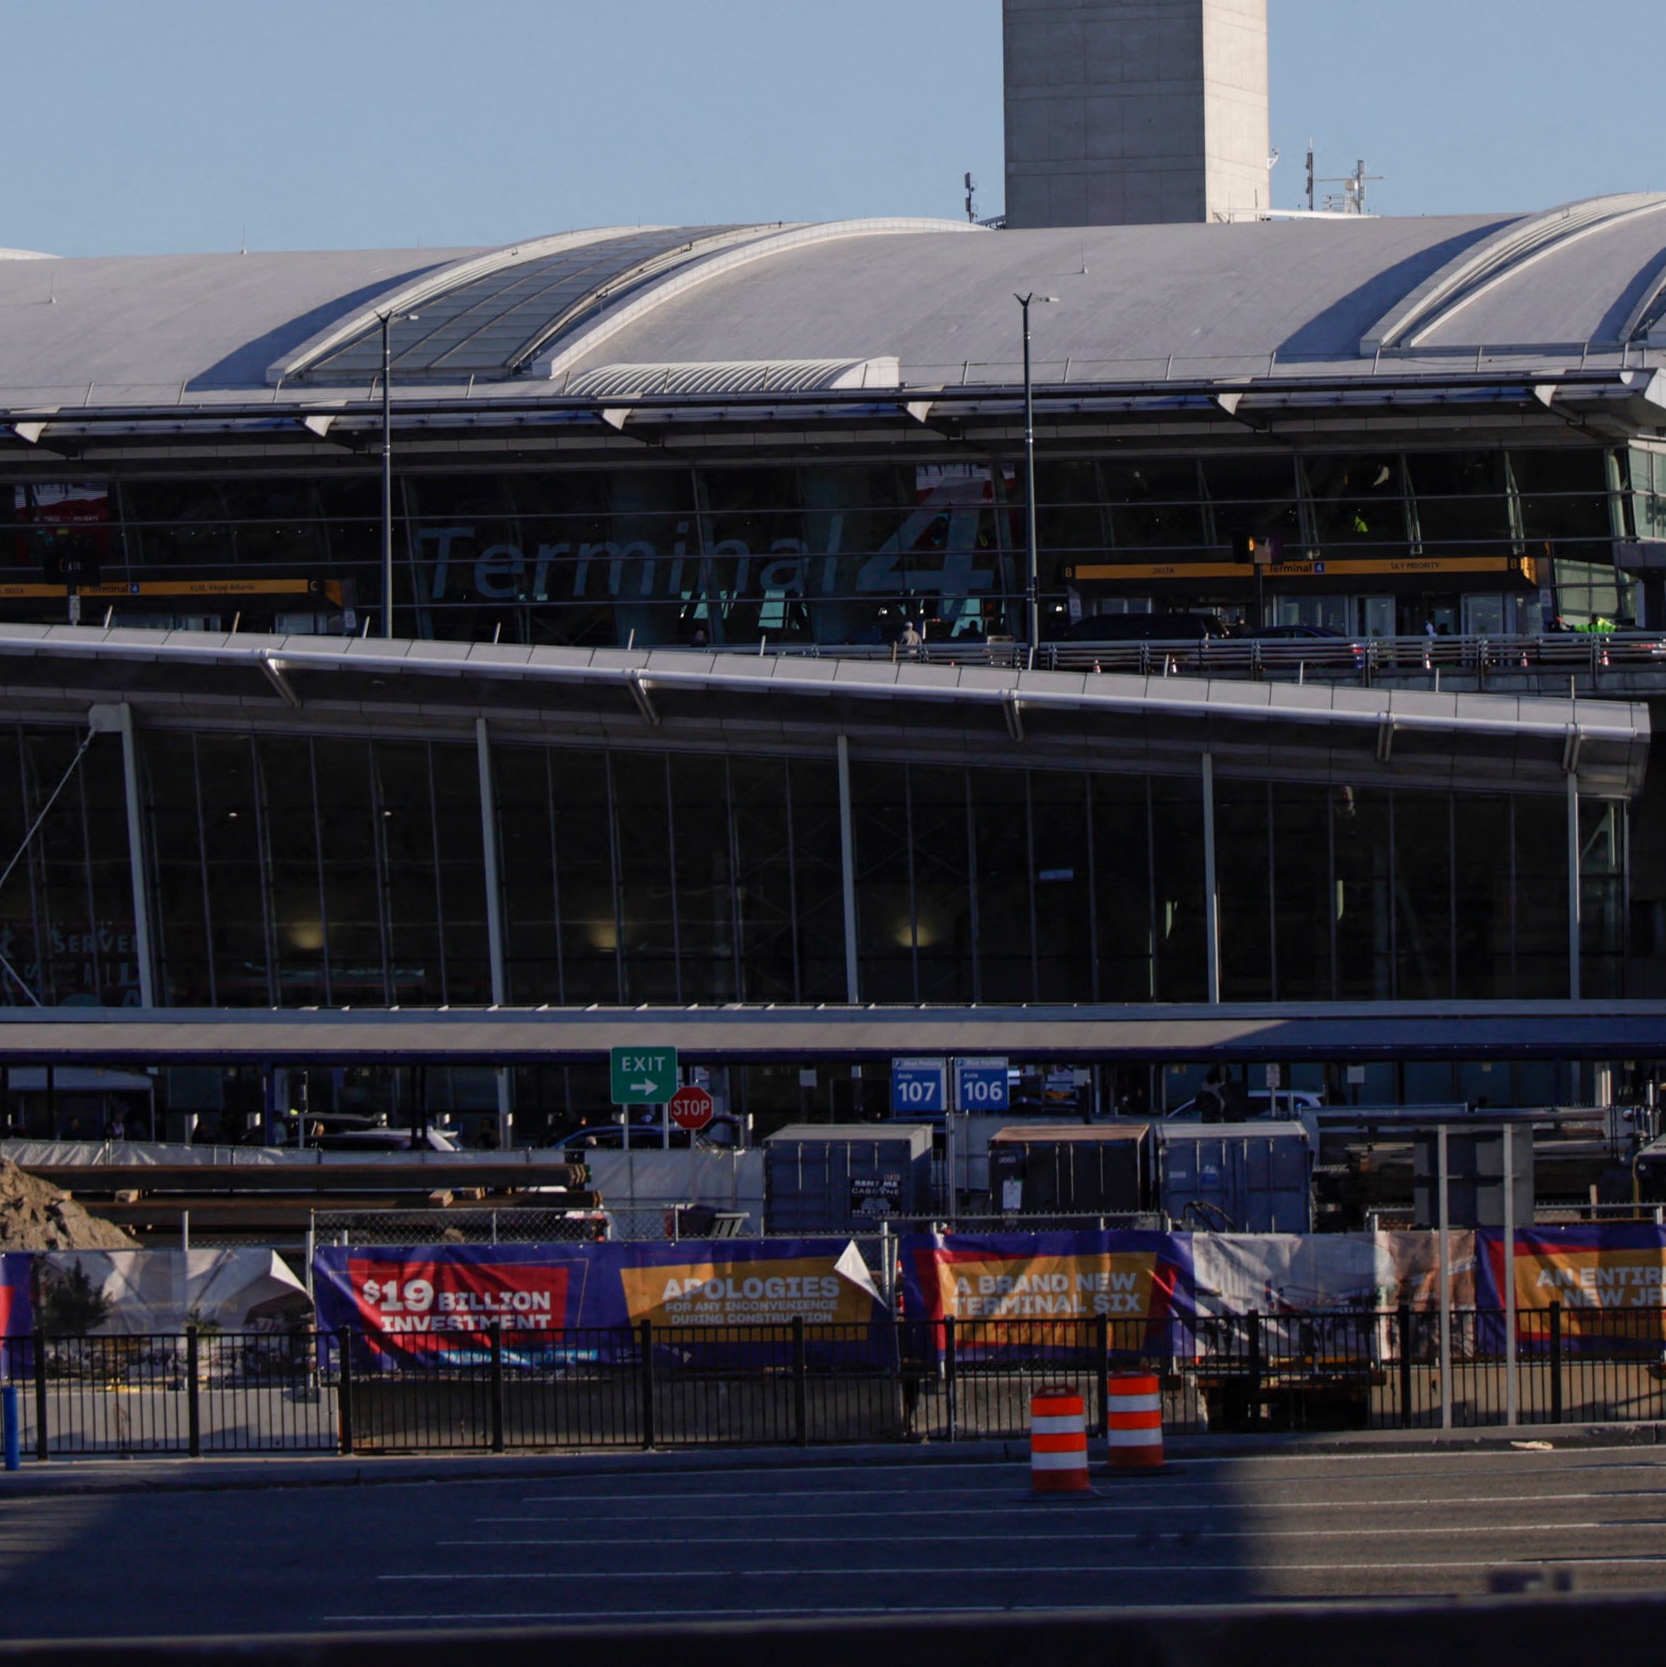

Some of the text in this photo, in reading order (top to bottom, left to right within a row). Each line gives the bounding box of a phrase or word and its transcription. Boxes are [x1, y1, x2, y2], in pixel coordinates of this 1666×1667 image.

[414, 476, 995, 621] Terminal 4
[621, 1056, 666, 1072] EXIT
[898, 1082, 935, 1102] 107
[963, 1081, 1003, 1101] 106
[673, 1099, 710, 1116] STOP
[956, 1272, 1137, 1296] A BRAND NEW
[1536, 1267, 1574, 1288] AN
[363, 1278, 552, 1312] $19 BILLION
[662, 1275, 841, 1301] APOLOGIES
[1563, 1287, 1625, 1307] NEW
[665, 1299, 838, 1313] FOR ANY INCONVENIENCE
[951, 1292, 1142, 1316] TERMINAL SIX
[380, 1314, 552, 1333] INVESTMENT
[670, 1313, 724, 1325] DURING
